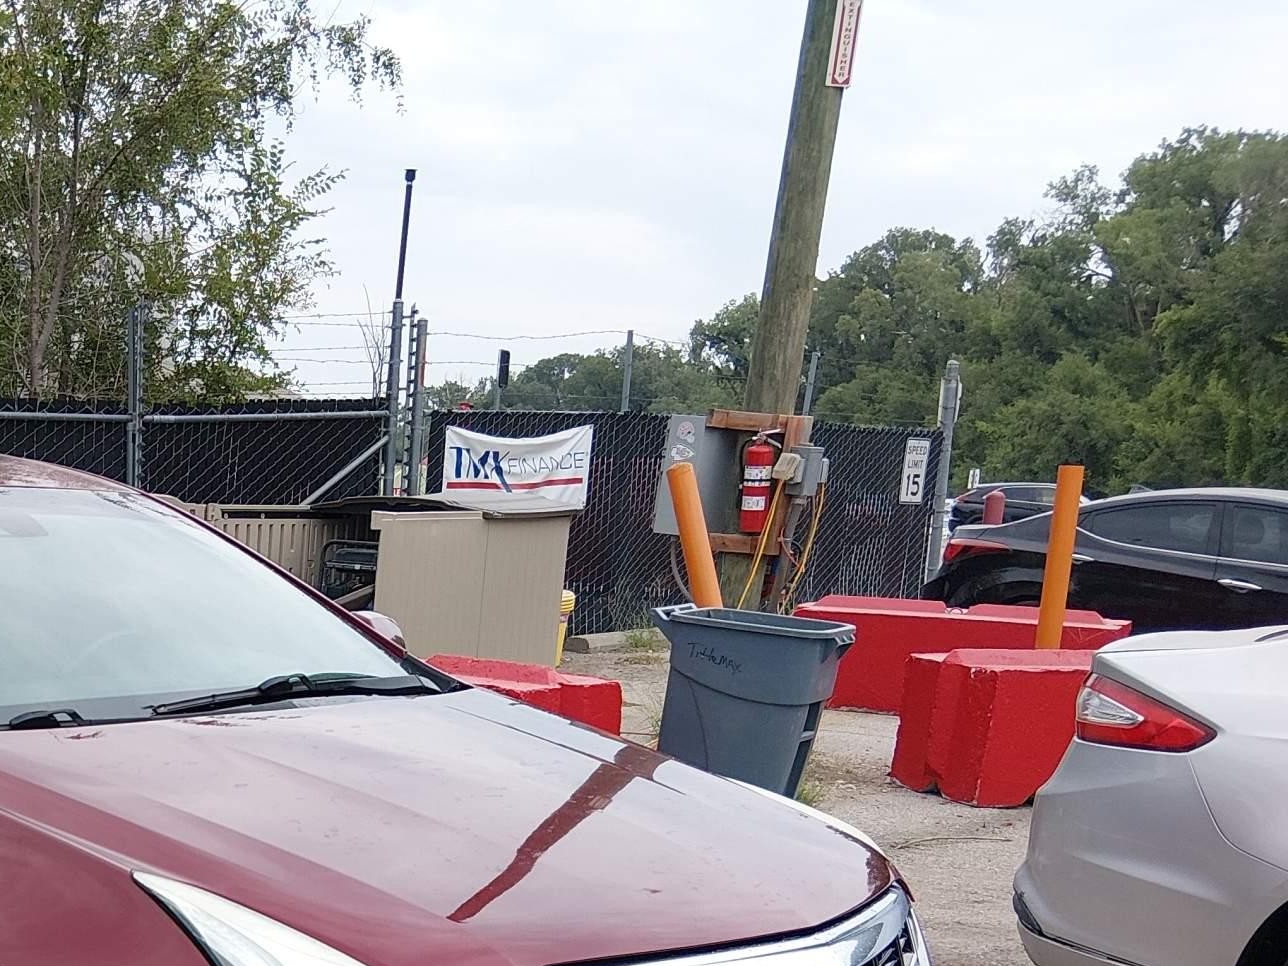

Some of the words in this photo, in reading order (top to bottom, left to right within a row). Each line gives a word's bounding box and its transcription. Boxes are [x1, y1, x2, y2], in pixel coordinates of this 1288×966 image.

[838, 2, 856, 77] EXTINGUISHER
[907, 446, 927, 455] SPEED
[449, 446, 512, 493] TMX
[507, 451, 585, 475] FINANCE
[908, 460, 923, 468] LIMIT
[906, 474, 920, 496] 15
